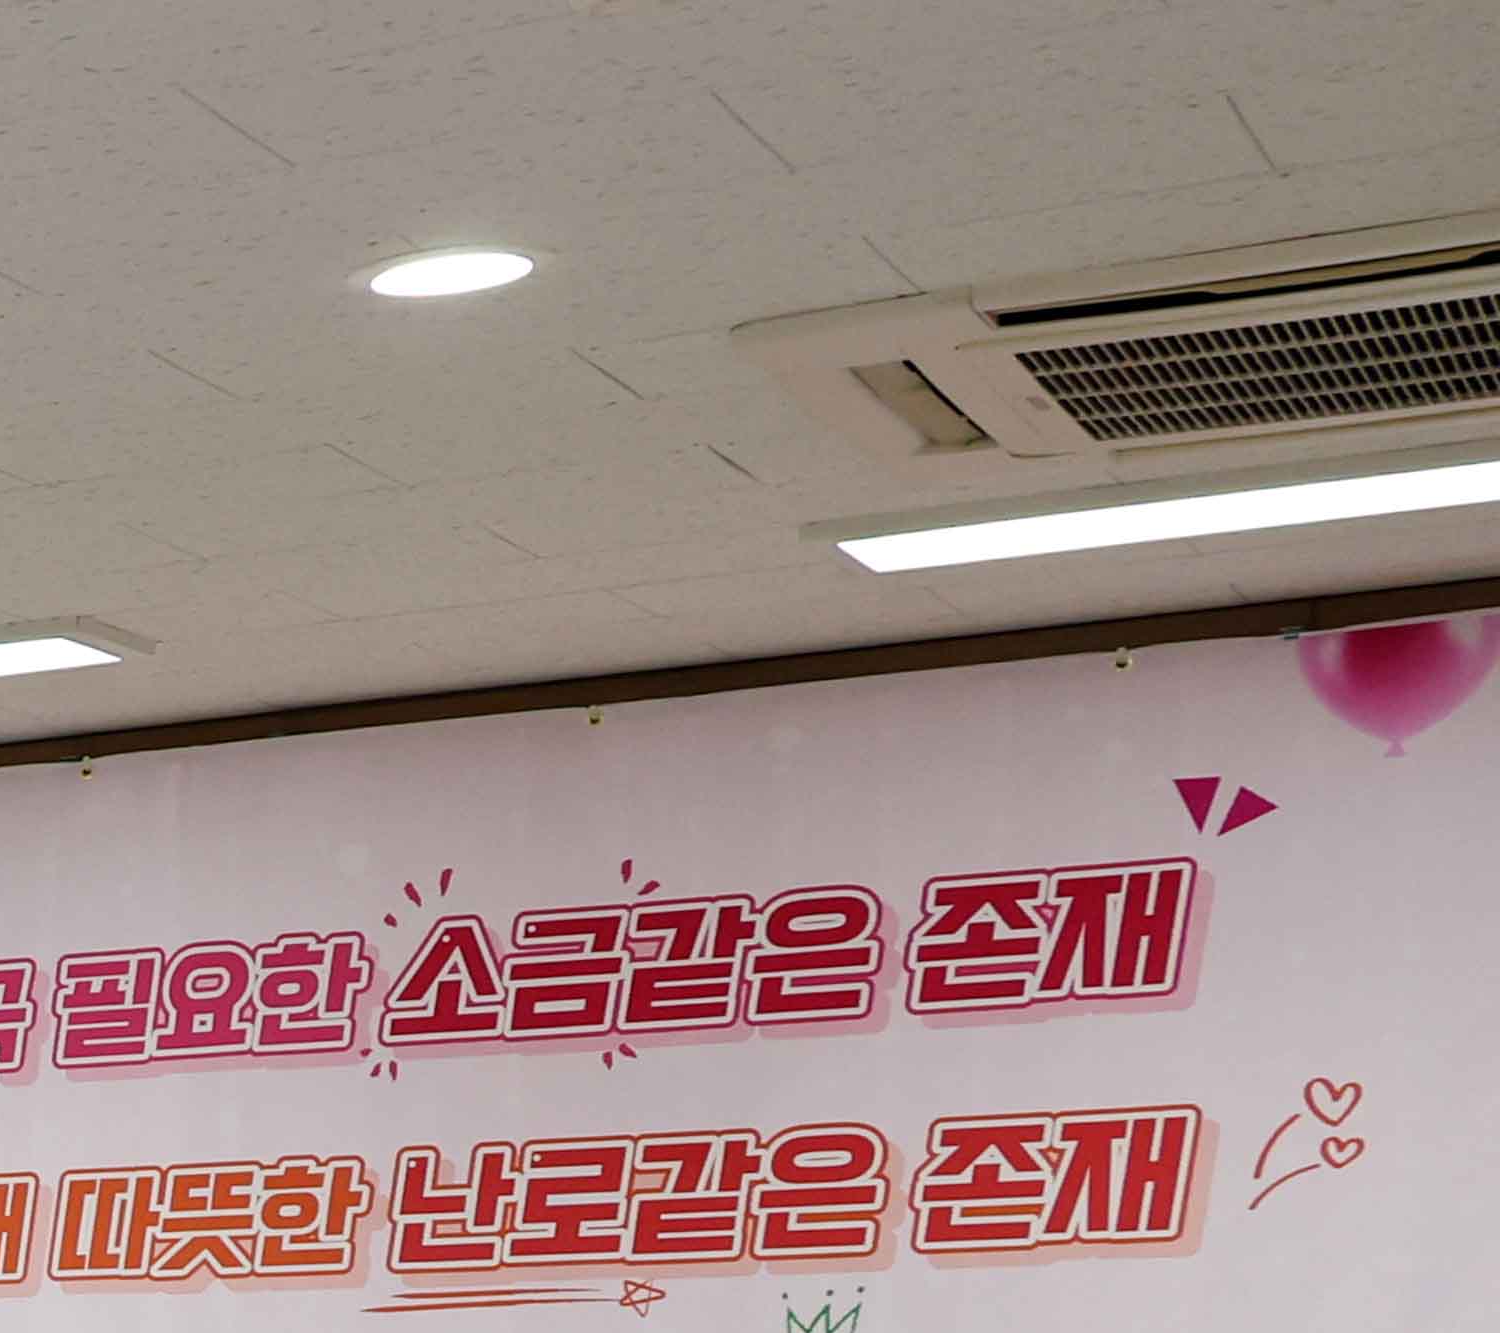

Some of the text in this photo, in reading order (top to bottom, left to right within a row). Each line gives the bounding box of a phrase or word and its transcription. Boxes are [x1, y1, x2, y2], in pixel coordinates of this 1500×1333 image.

[52, 930, 372, 1070] 필요한
[378, 885, 886, 1050] 소금같은
[906, 857, 1198, 1014] 존재
[50, 1156, 372, 1282] 따뜻한
[387, 1123, 890, 1275] 난로같은
[912, 1104, 1203, 1257] 존재
